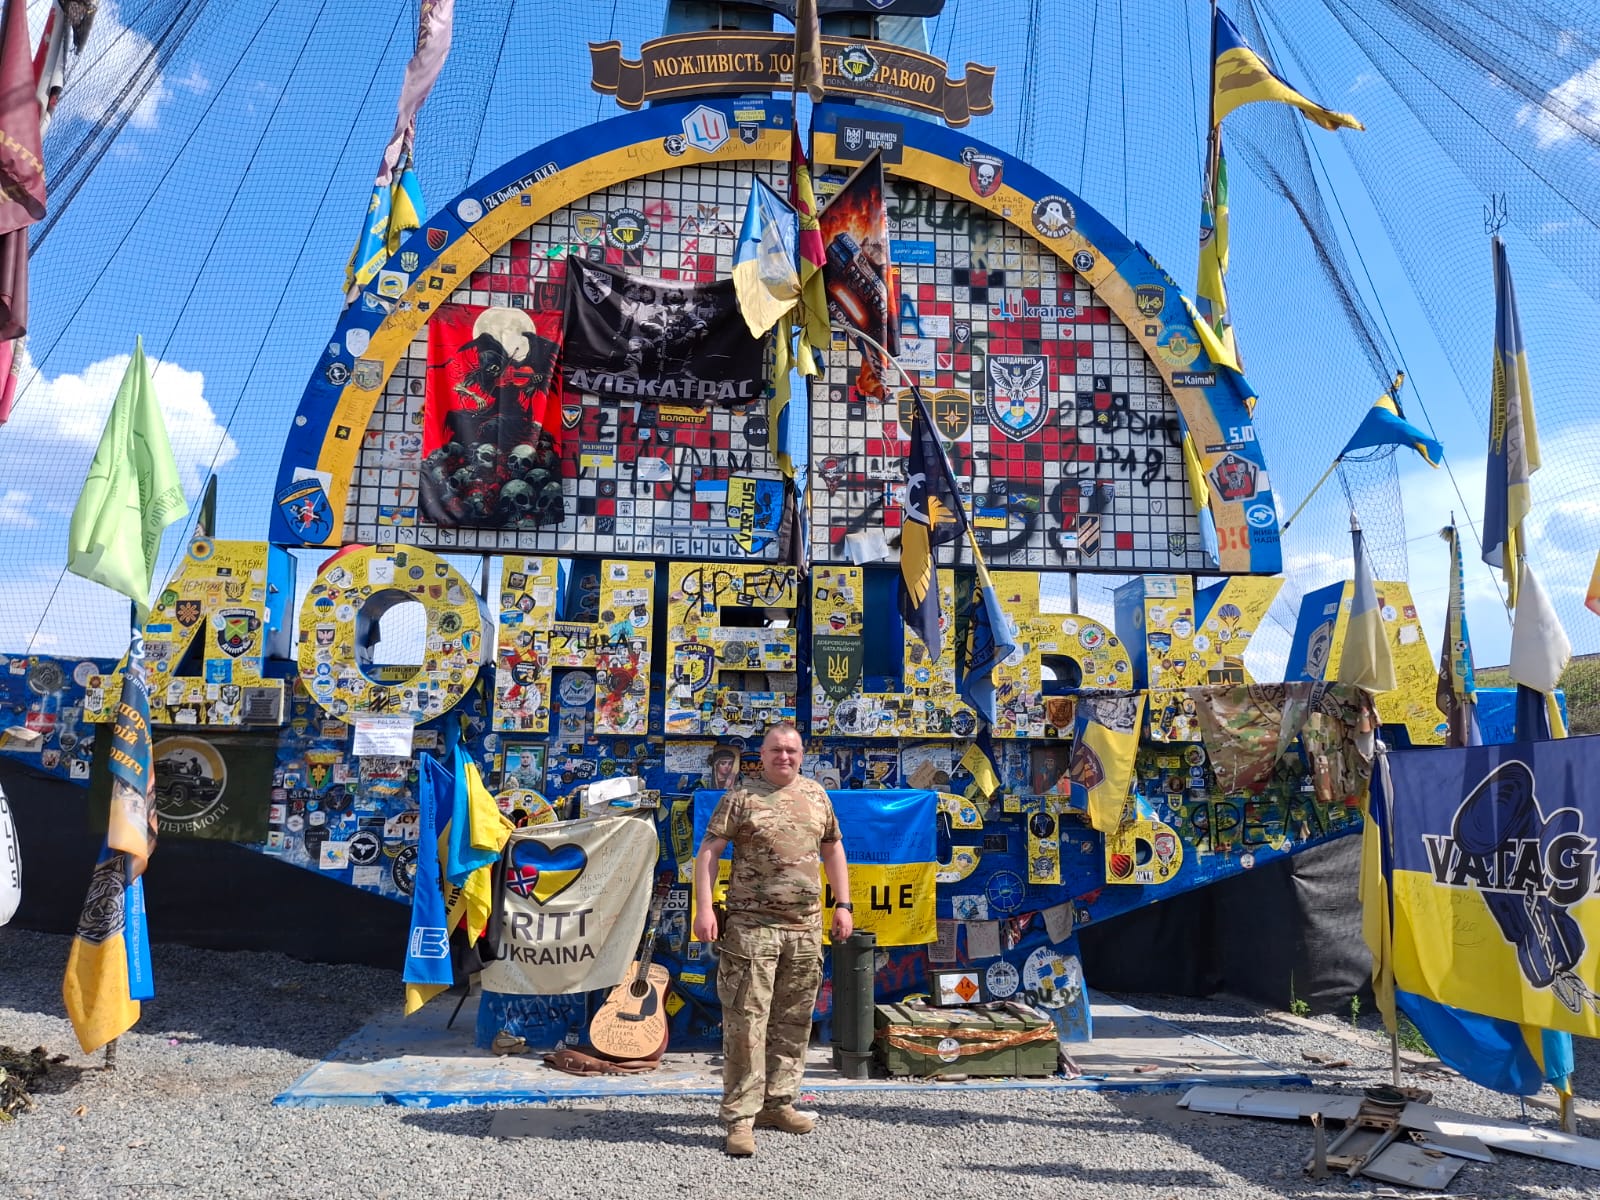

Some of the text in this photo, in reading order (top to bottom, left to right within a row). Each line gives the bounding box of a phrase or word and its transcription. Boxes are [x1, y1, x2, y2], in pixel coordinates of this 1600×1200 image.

[652, 53, 764, 79] МОЖЛИВІСТЬ
[486, 195, 499, 210] 24
[611, 208, 645, 220] ВОЛОНТЕР
[569, 370, 753, 400] АЛЬКАТРАС
[660, 414, 705, 424] ВОЛОНТЕР
[740, 482, 756, 543] VIRTUS
[145, 643, 166, 651] REE
[683, 645, 707, 653] СЛАВА
[1422, 832, 1600, 905] VATAG
